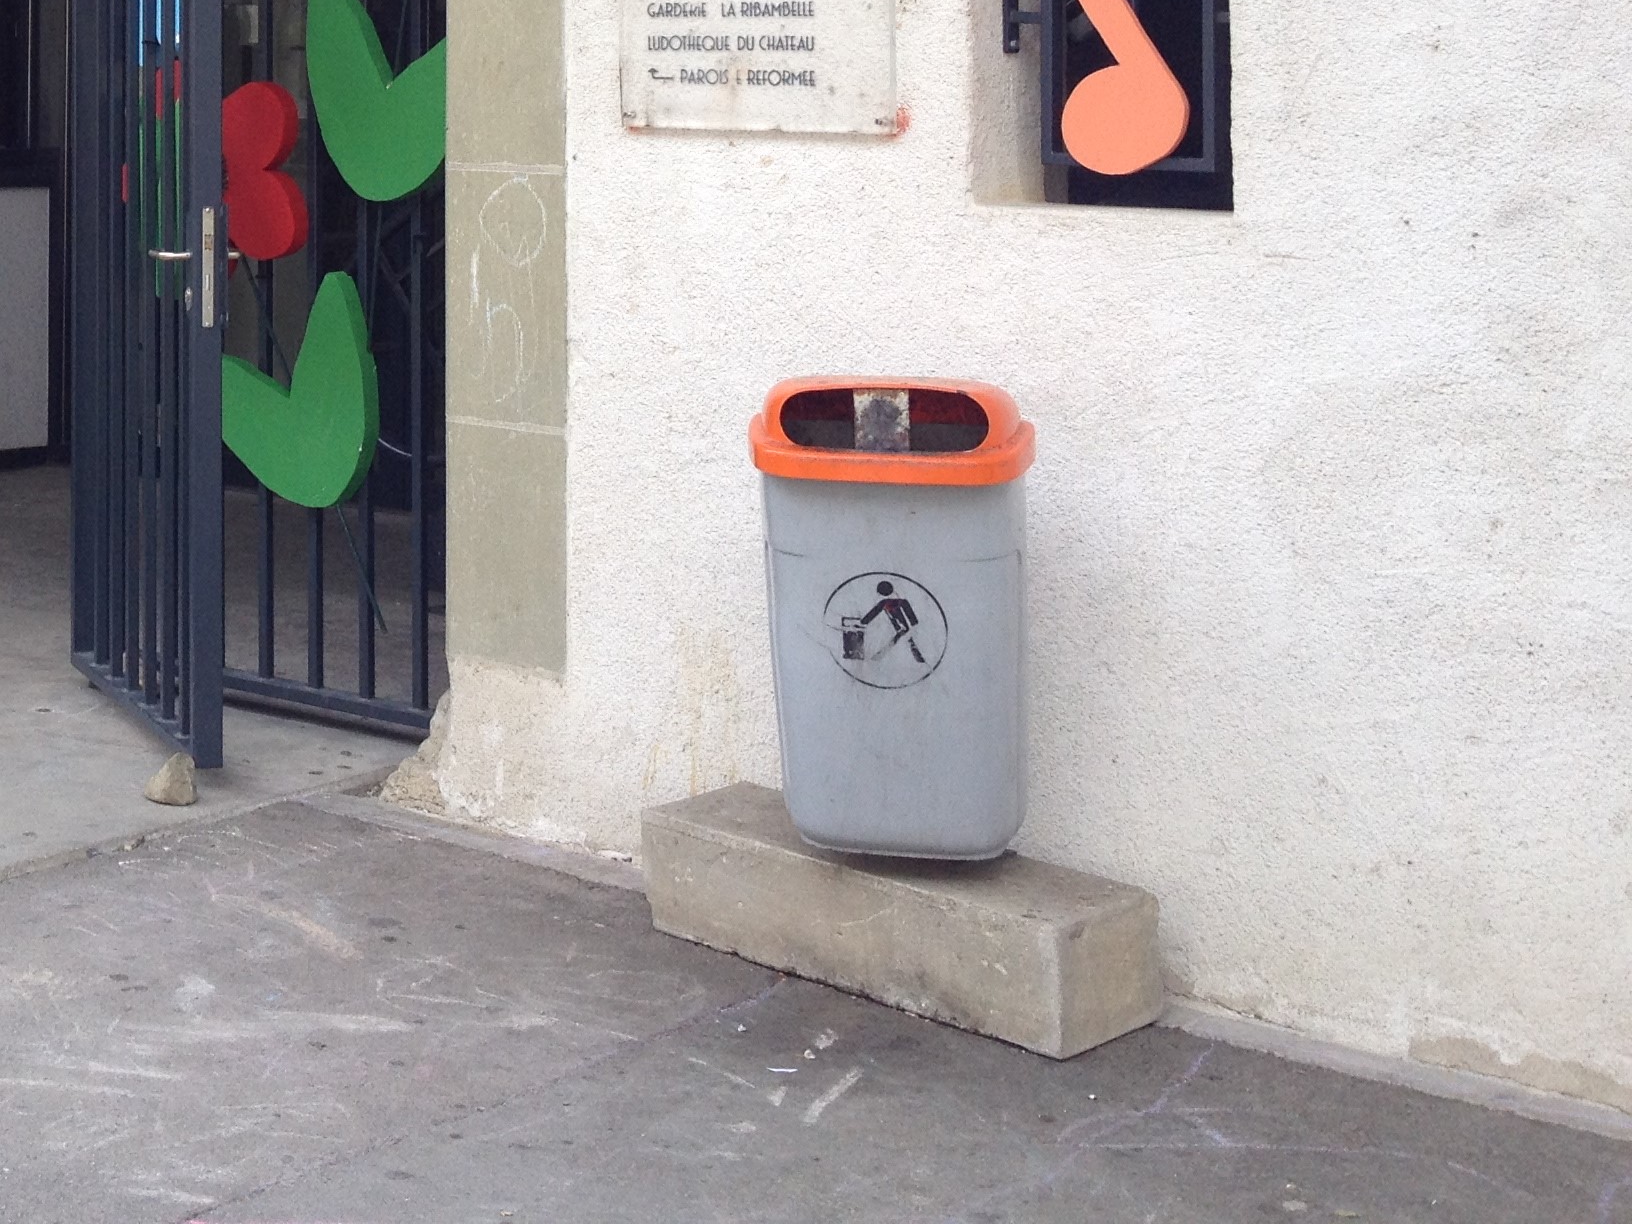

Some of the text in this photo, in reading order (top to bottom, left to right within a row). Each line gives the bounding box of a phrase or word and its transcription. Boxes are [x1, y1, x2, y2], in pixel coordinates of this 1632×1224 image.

[721, 2, 736, 18] LA
[740, 1, 815, 17] RIBAMBELLE
[647, 35, 815, 52] LUDOTHEQUE DU CHATEAU
[746, 69, 816, 87] REFORMEE
